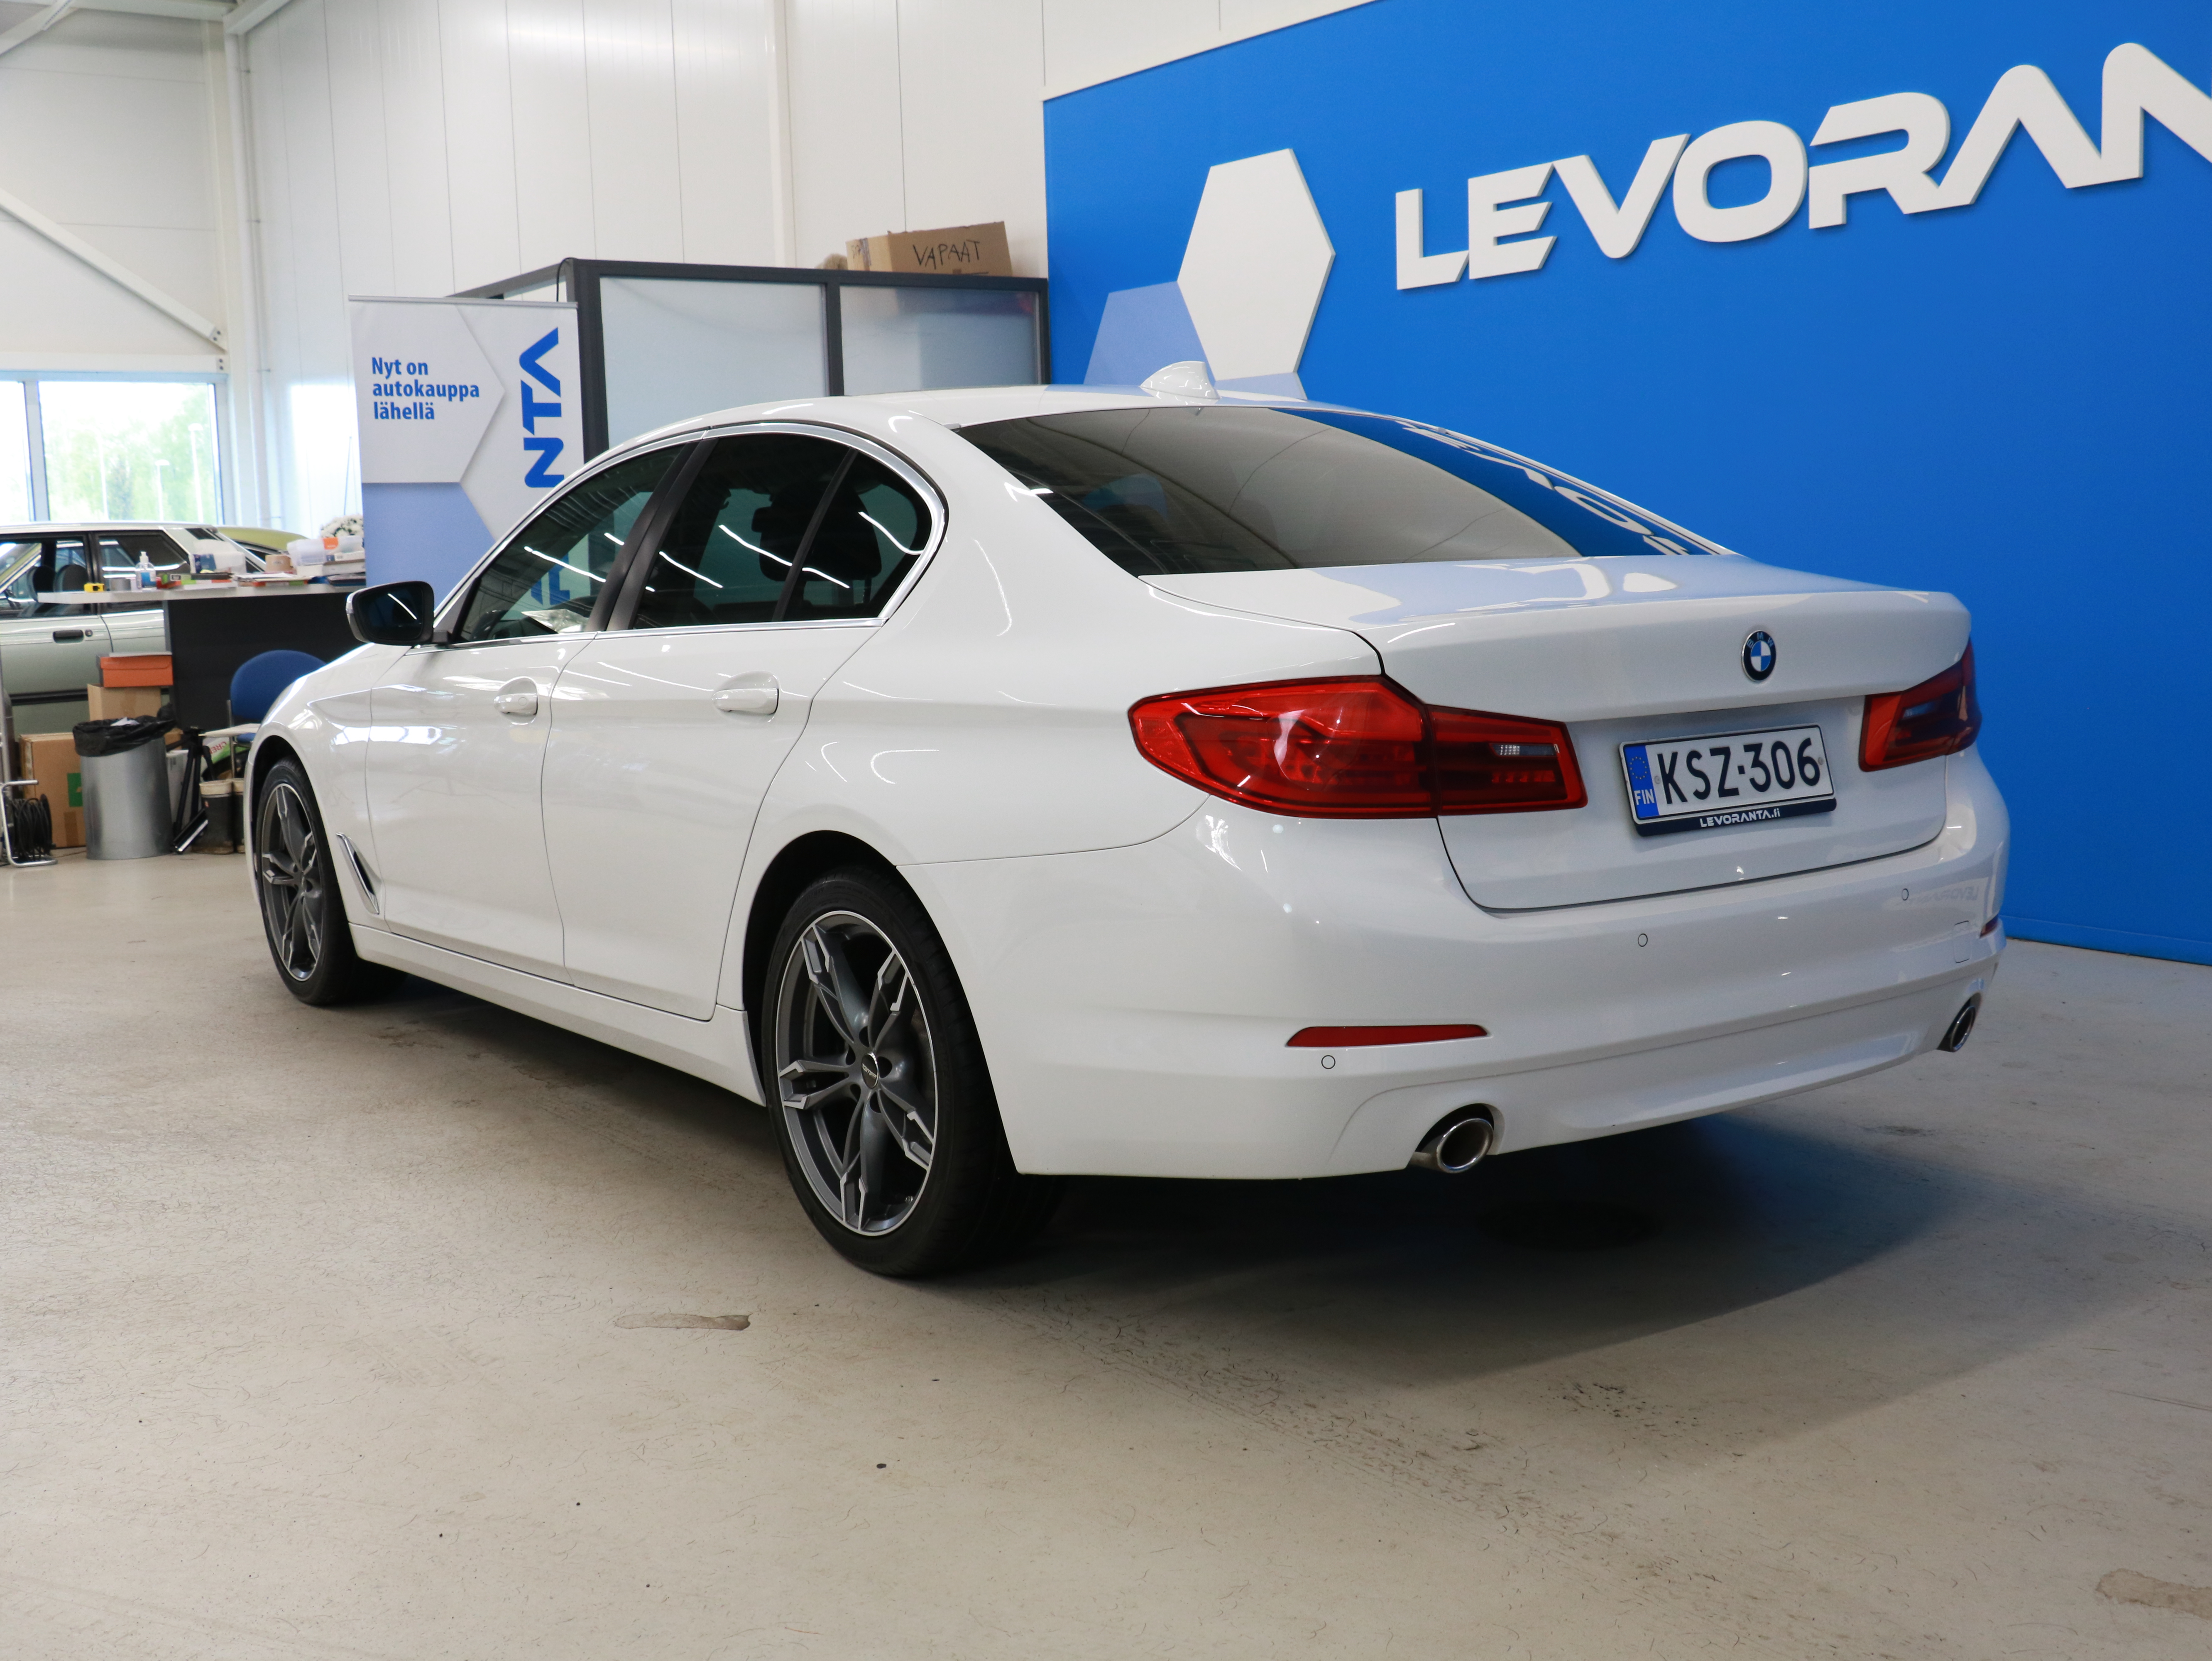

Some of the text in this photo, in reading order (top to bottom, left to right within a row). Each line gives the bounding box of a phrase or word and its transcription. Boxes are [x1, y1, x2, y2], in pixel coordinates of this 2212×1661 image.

[913, 239, 980, 270] VAPAAT
[372, 357, 428, 380] Nyt on
[372, 379, 479, 402] autokauppa
[374, 401, 435, 419] lähellä
[1746, 632, 1774, 649] BMW
[1633, 789, 1655, 806] FIN
